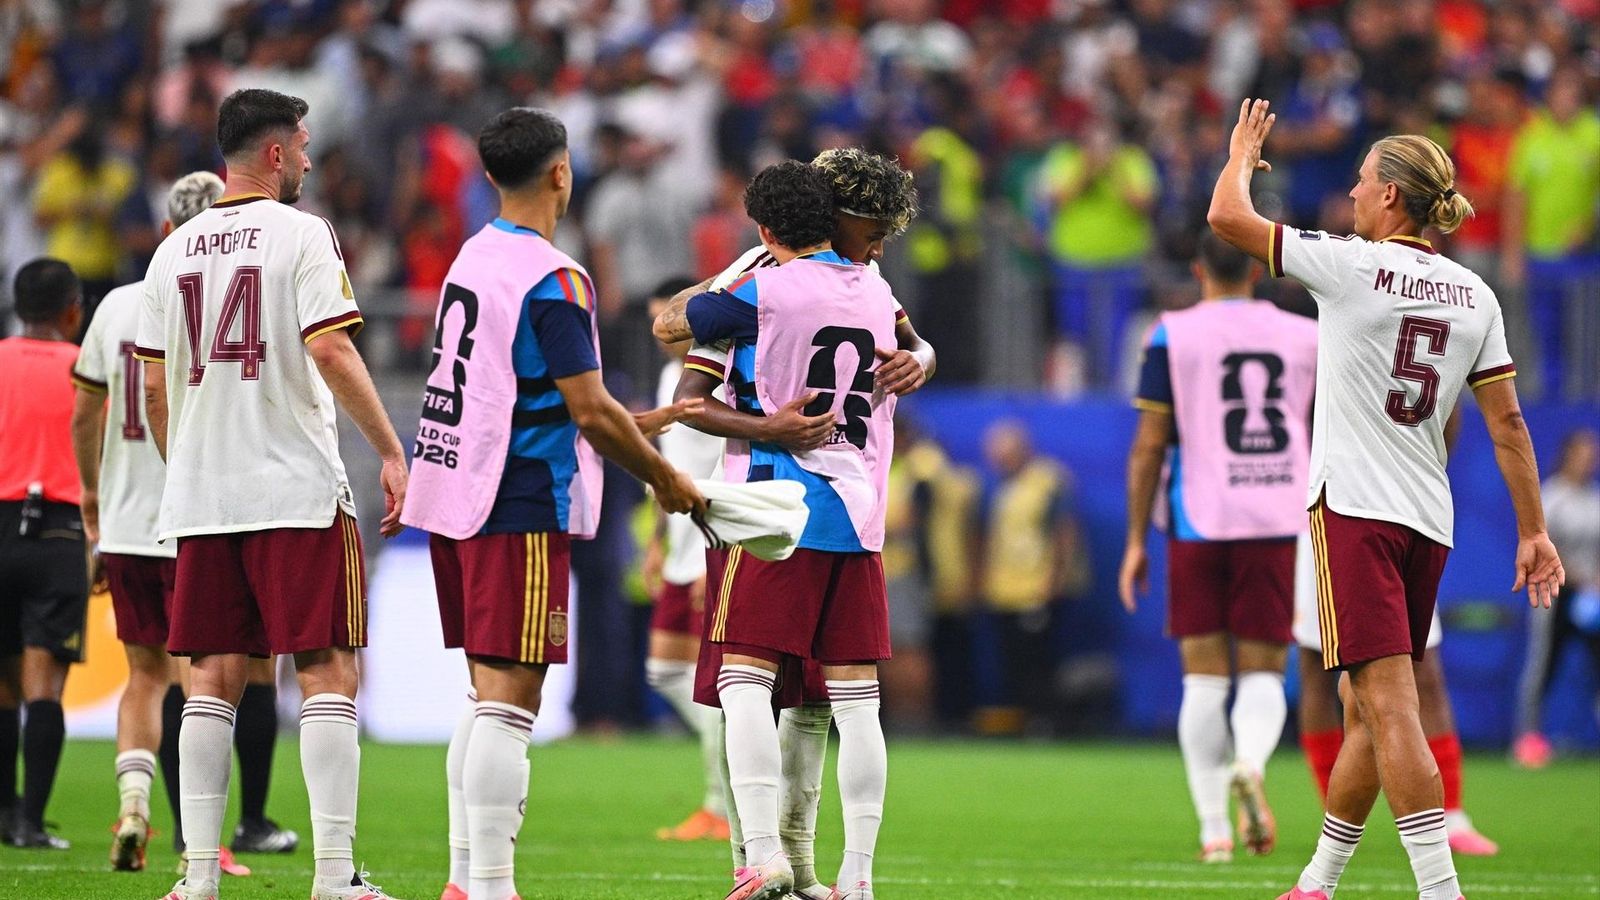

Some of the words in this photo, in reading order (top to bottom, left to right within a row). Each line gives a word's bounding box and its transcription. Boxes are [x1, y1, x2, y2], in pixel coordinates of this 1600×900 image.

[185, 228, 261, 257] LAPORTE
[1374, 268, 1396, 295] M.
[1401, 274, 1475, 309] LLORENTE
[177, 265, 266, 386] 14
[1384, 314, 1451, 427] 5
[442, 433, 461, 447] CUP
